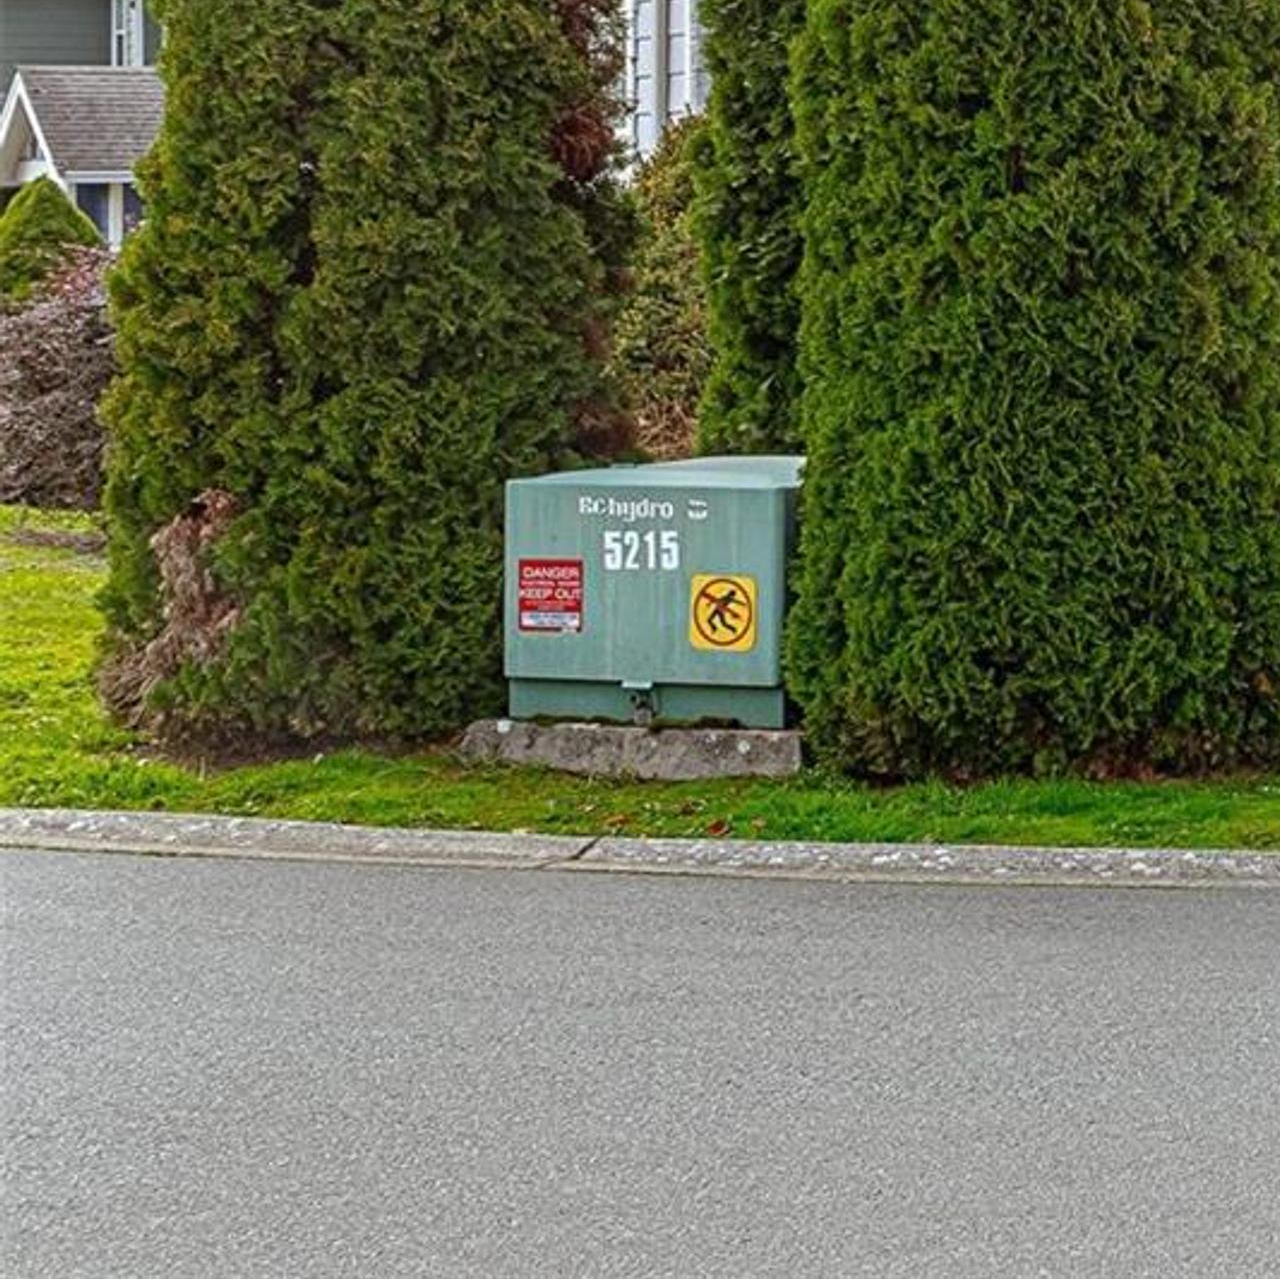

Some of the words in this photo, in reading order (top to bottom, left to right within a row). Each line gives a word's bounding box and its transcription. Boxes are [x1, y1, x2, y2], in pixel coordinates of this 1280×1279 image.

[604, 530, 679, 570] 5215
[523, 566, 580, 579] DANGER
[519, 588, 554, 599] KEEP
[554, 588, 582, 600] OUT
